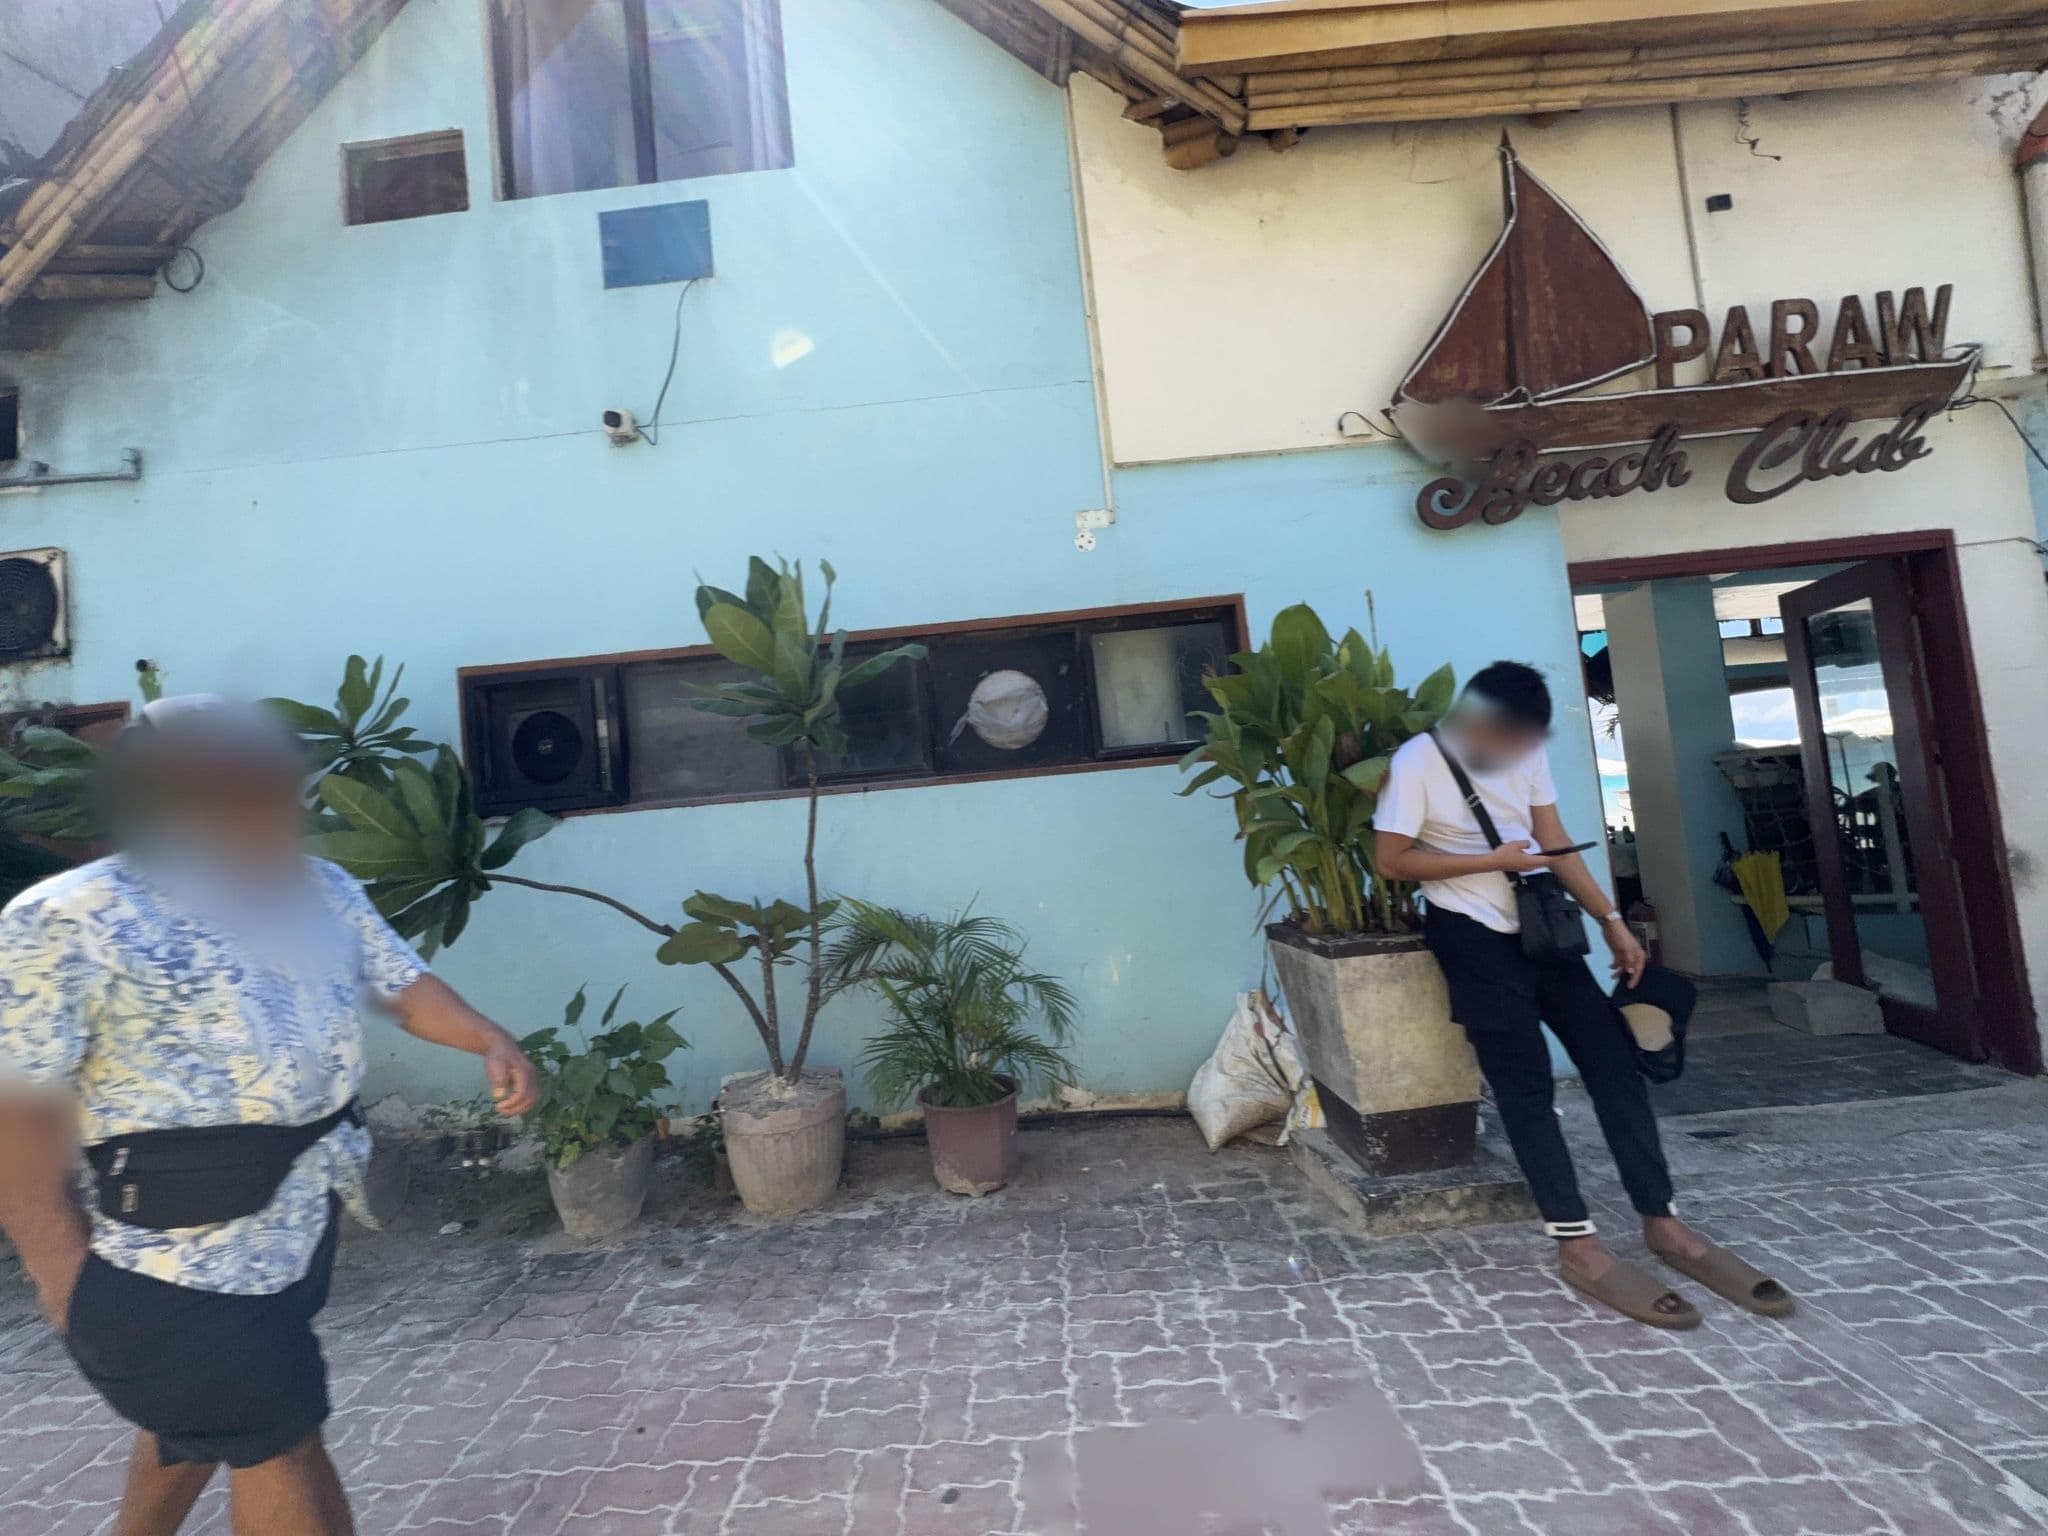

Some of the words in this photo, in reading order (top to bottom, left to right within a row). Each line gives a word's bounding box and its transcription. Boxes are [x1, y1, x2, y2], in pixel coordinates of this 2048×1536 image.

[1654, 284, 1953, 388] PARAW
[1417, 422, 1691, 530] Beach
[1725, 408, 1933, 504] Club
